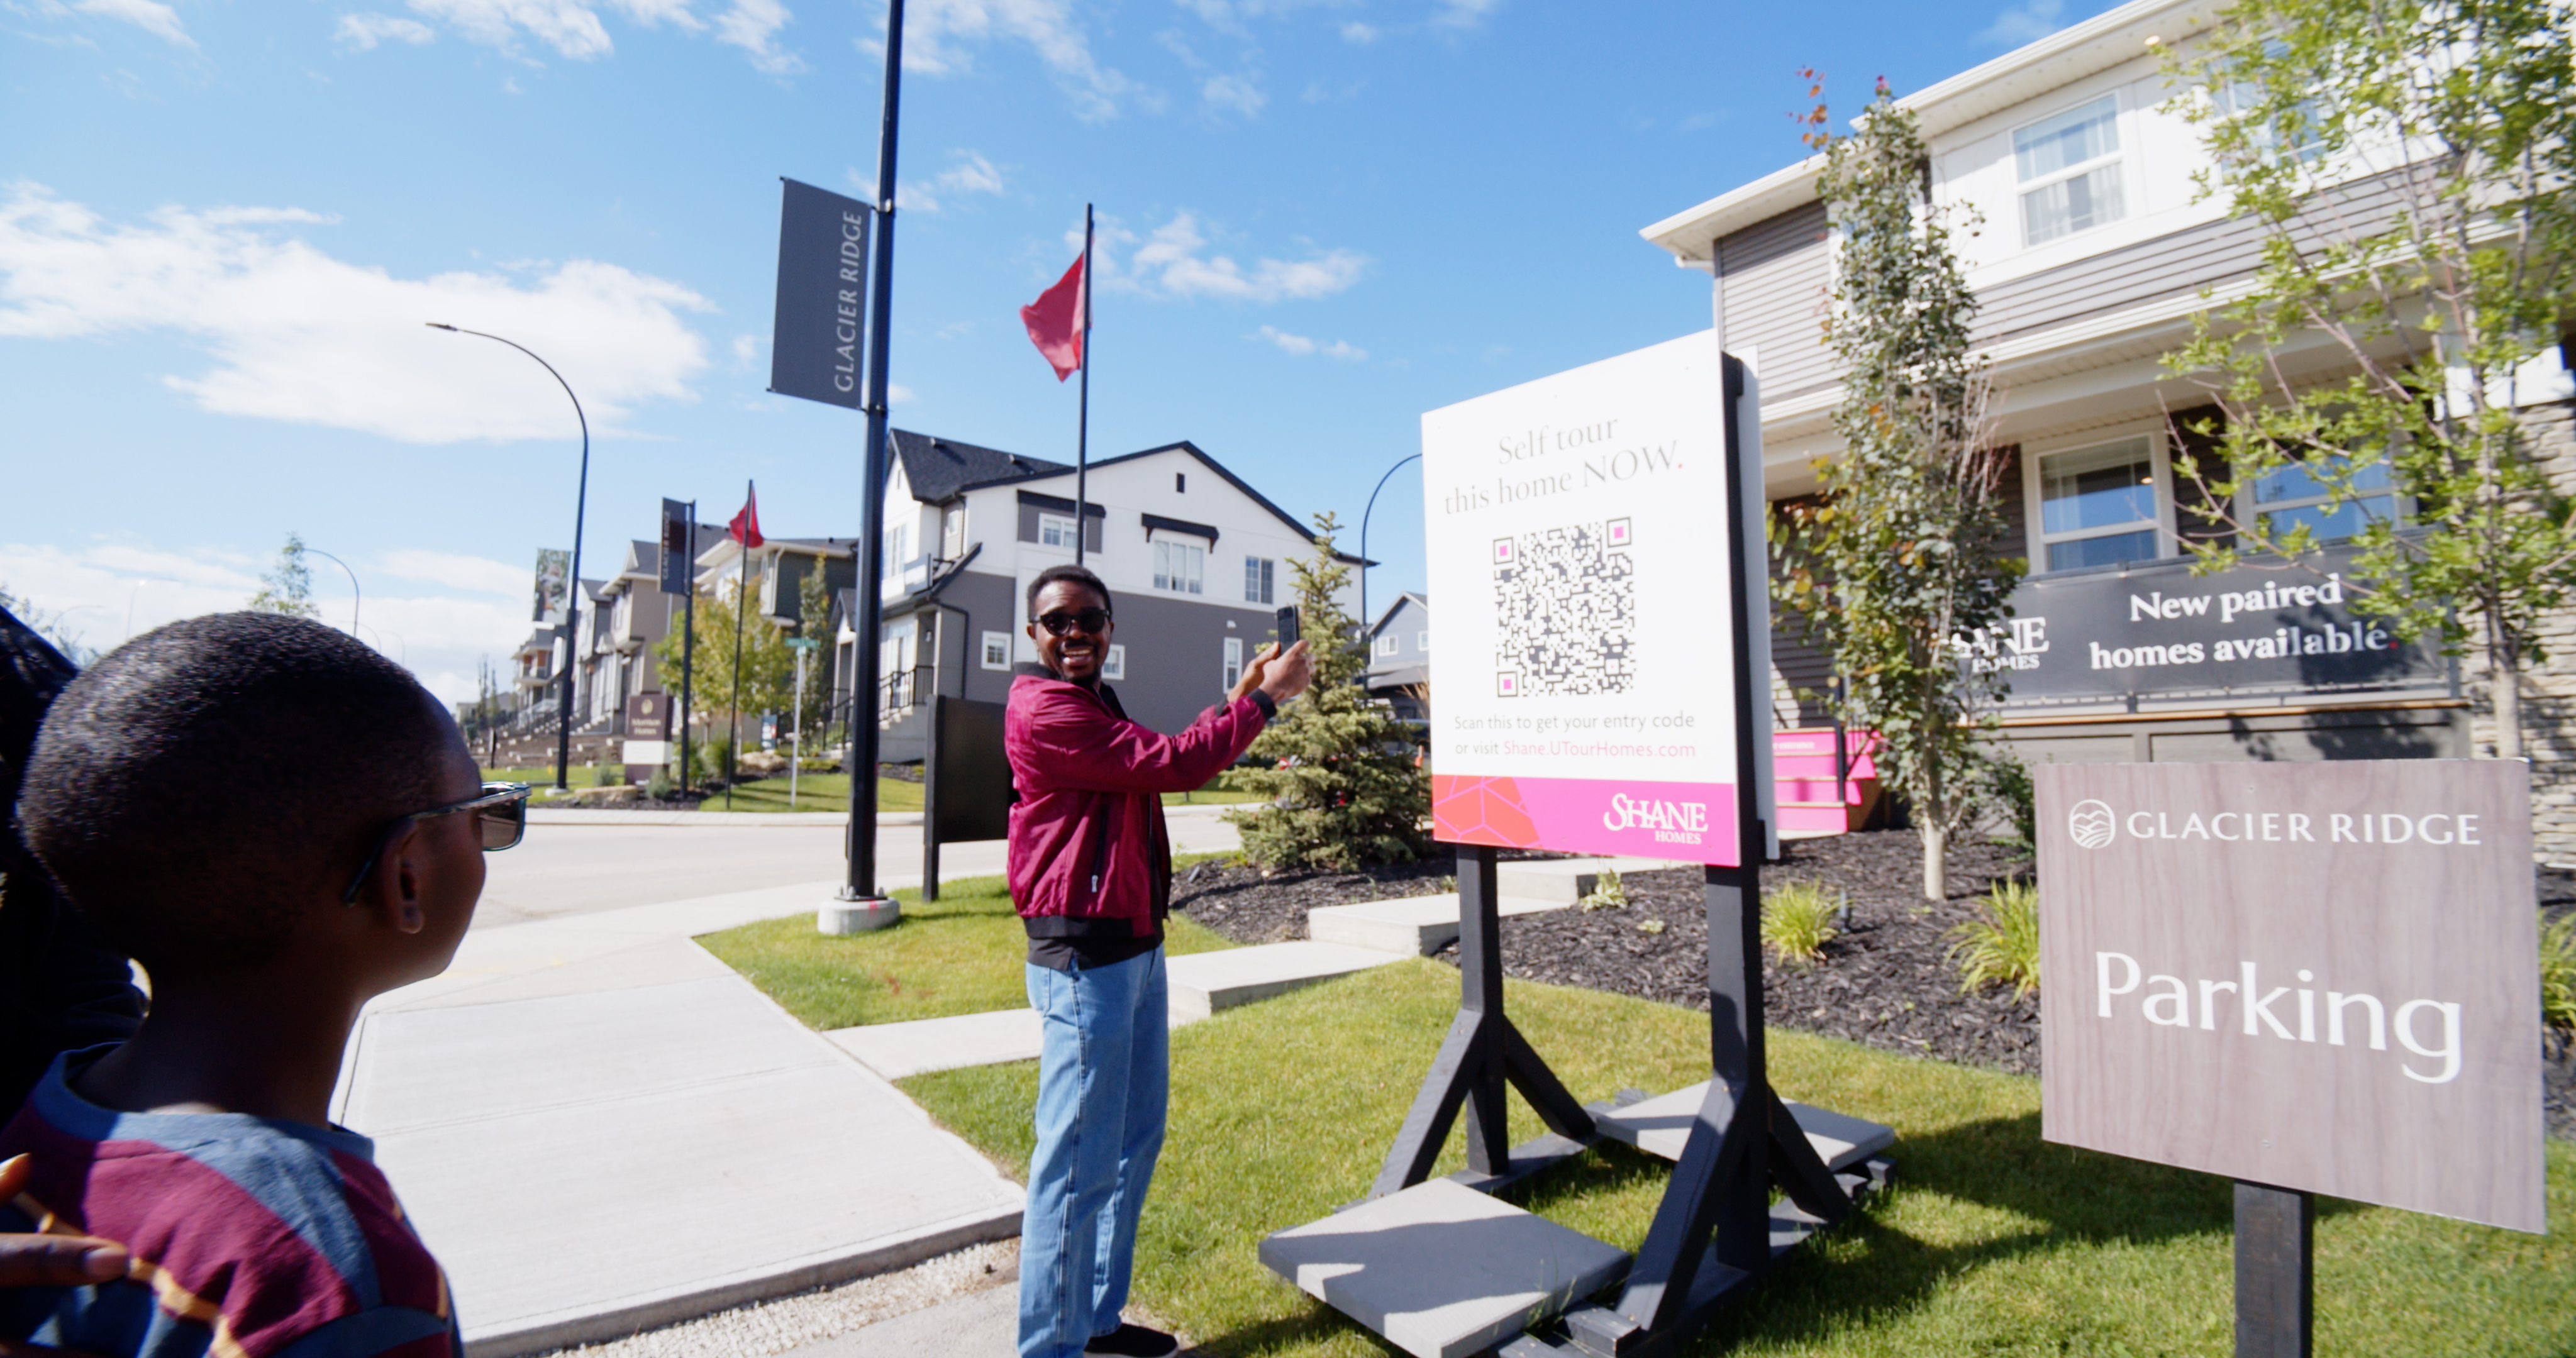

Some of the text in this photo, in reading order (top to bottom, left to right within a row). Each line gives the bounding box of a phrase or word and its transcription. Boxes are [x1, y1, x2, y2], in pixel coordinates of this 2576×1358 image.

[835, 211, 862, 392] GLACIER RIDGE
[1499, 419, 1618, 465] Self tour
[1445, 439, 1683, 515] this home NOW.
[2131, 573, 2343, 623] New paired
[2089, 621, 2399, 670] homes available.
[1455, 710, 1695, 733] Scan this to get your entry code
[1455, 741, 1696, 758] or visit Shane.UTourHomes.com
[1603, 793, 1709, 832] SHANE
[2127, 812, 2481, 845] GLACIER RIDGE
[1655, 830, 1702, 845] HOMES
[2096, 951, 2462, 1083] Parking
